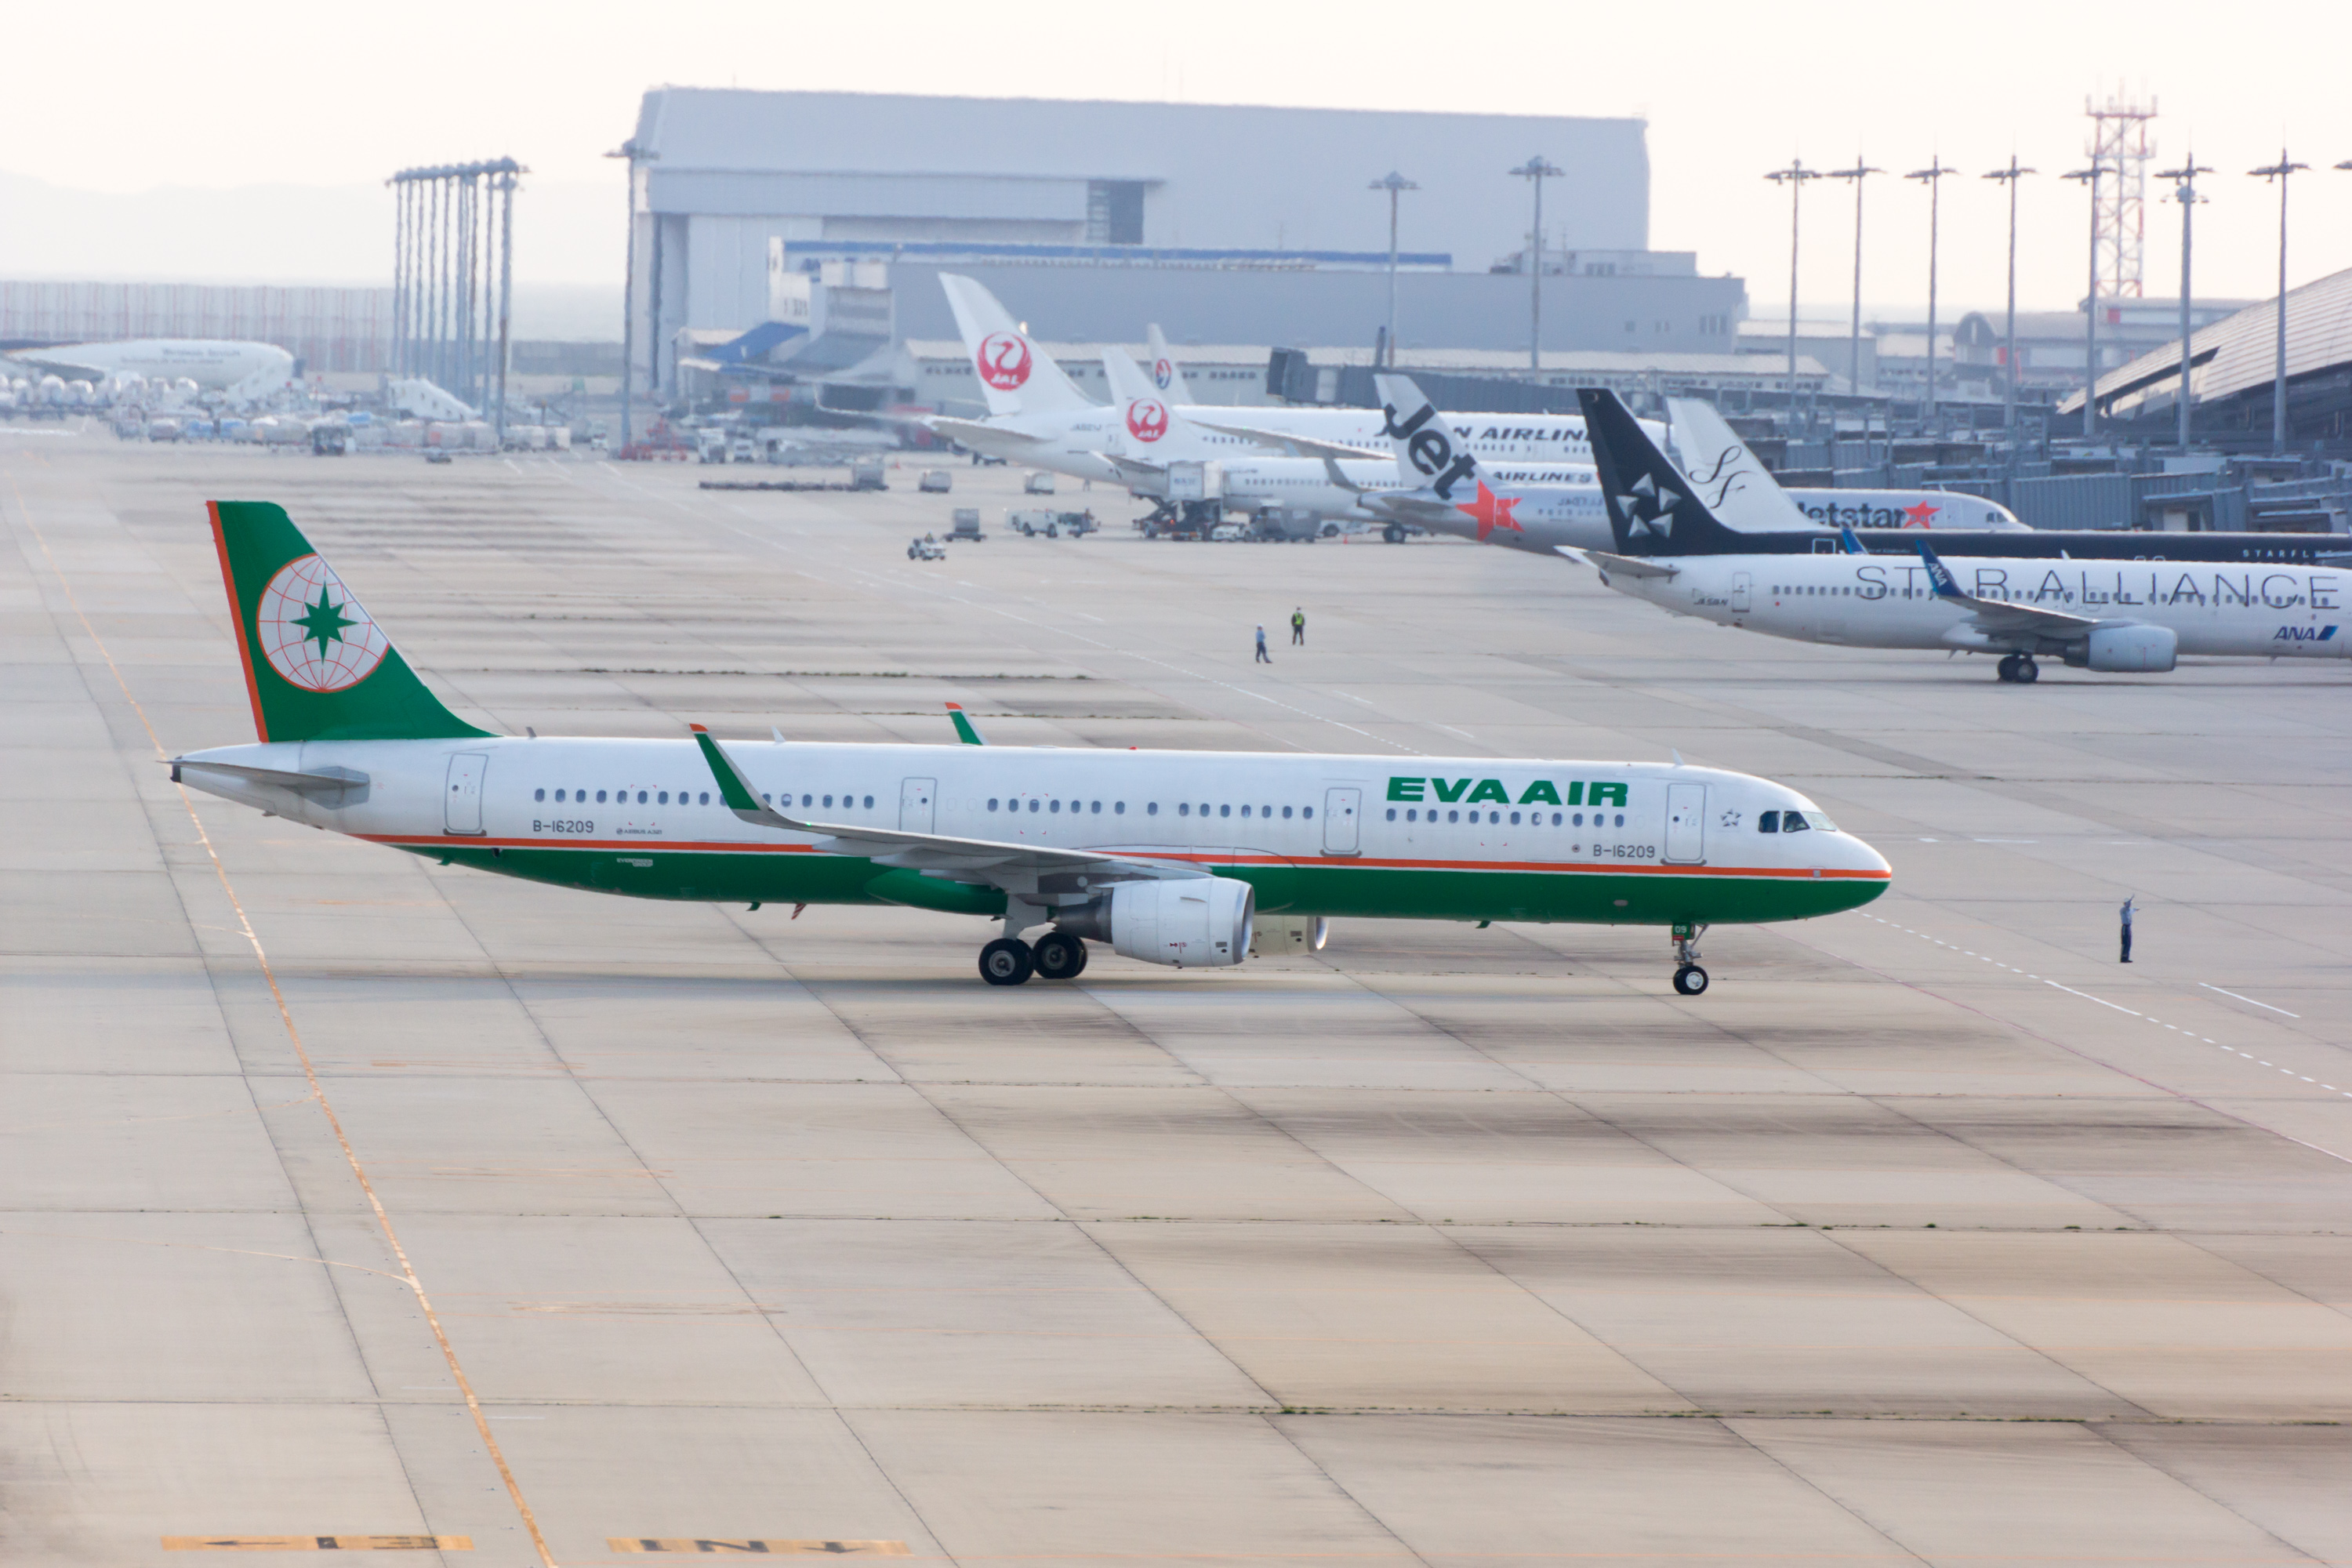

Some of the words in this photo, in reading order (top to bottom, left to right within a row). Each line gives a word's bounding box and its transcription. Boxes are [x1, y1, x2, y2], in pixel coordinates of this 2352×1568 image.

[991, 372, 1020, 385] JAL
[1479, 426, 1590, 441] AIRLIN
[1384, 402, 1476, 501] Jet
[1493, 471, 1592, 484] AIRLINES
[1927, 562, 1948, 587] ANA
[1856, 566, 2009, 602] STR
[2034, 568, 2341, 610] ALLIANCE
[2273, 626, 2315, 641] ANA
[533, 820, 594, 833] B-16209
[1593, 844, 1655, 858] B-16209
[1675, 925, 1687, 934] 09
